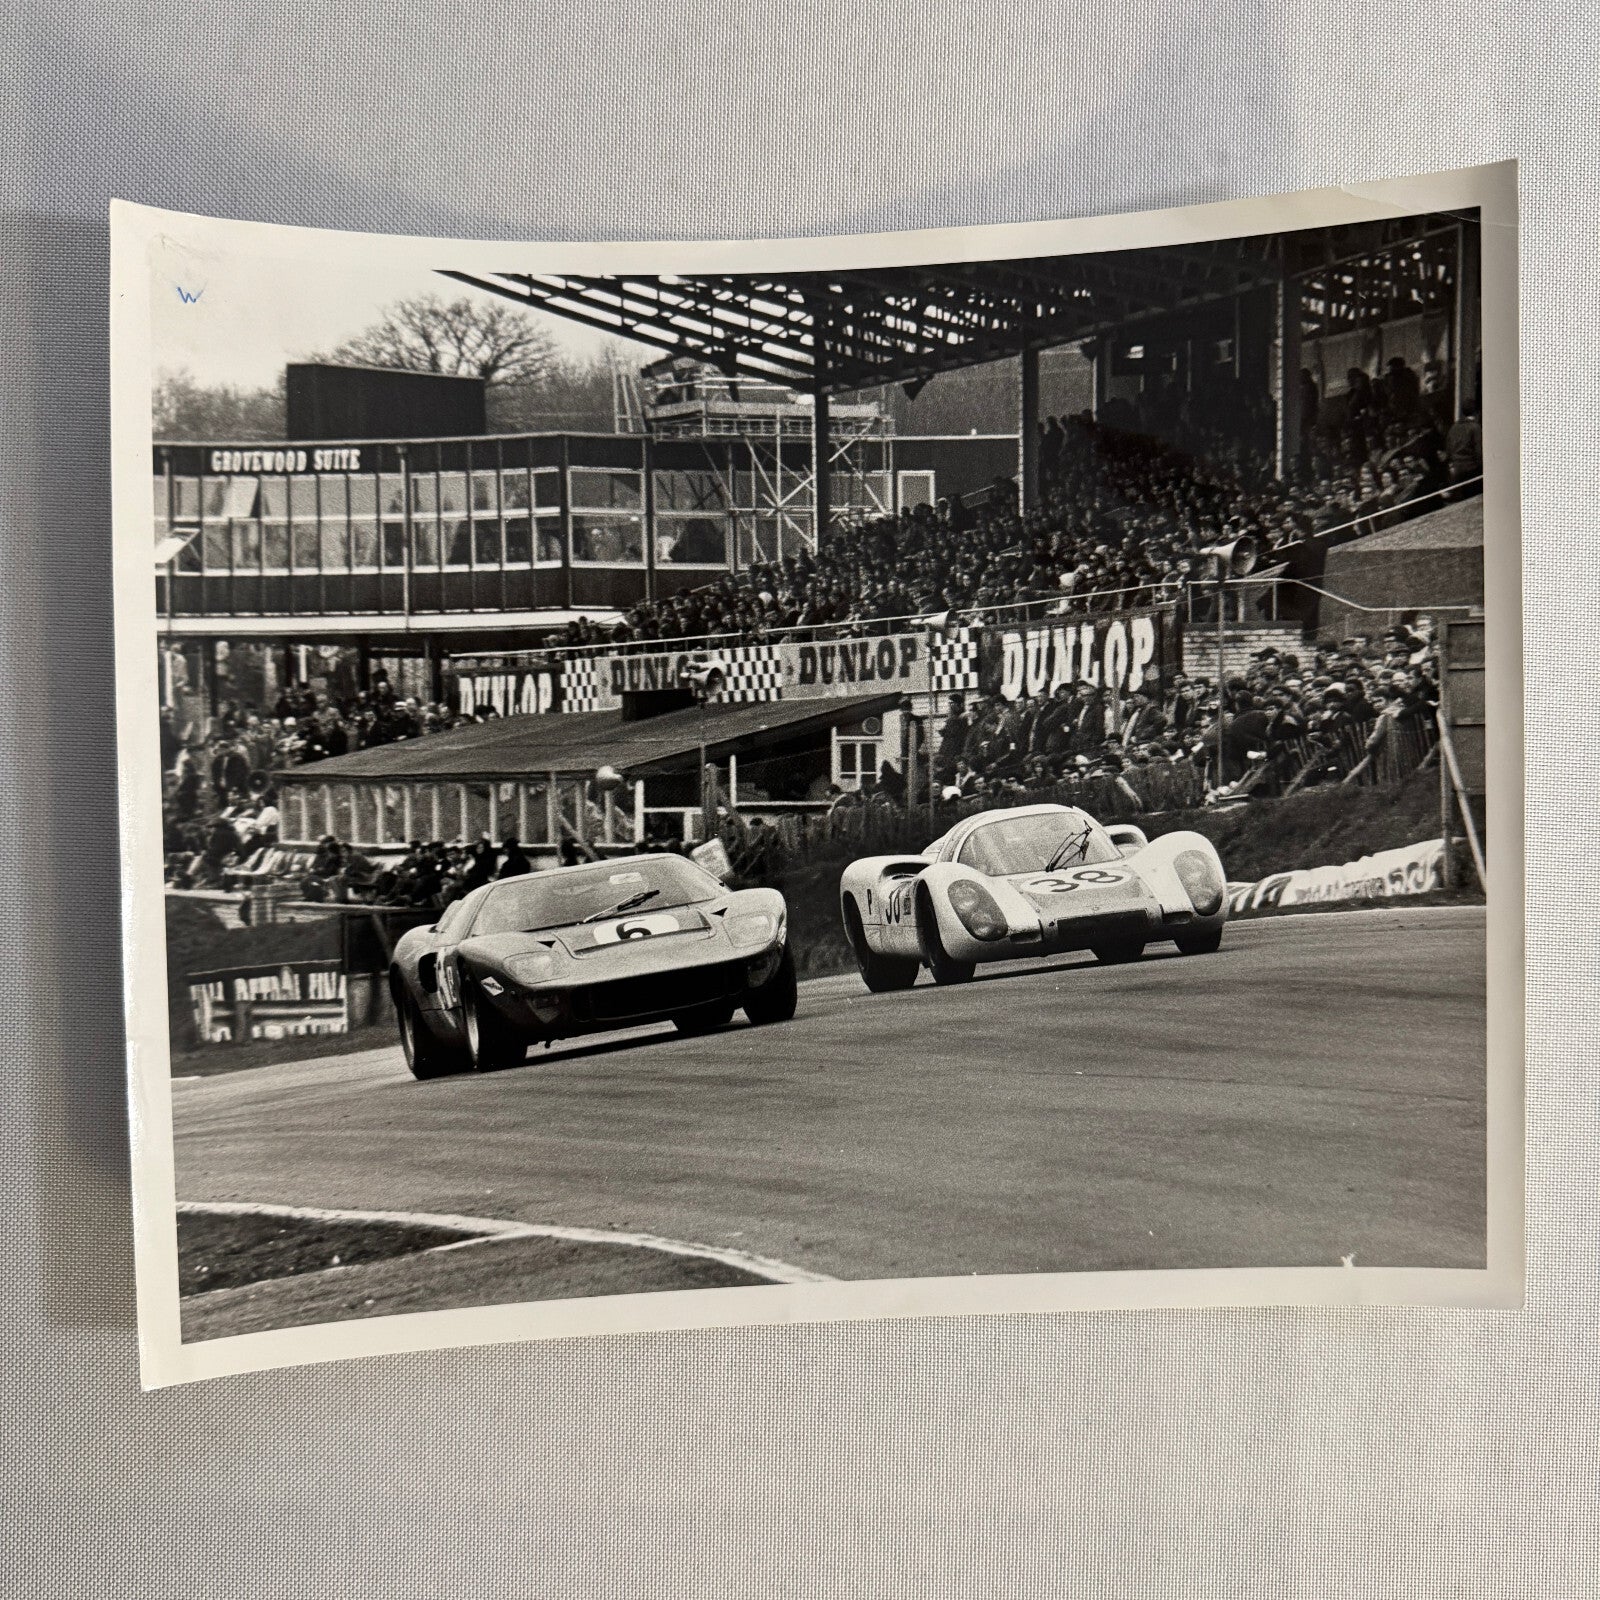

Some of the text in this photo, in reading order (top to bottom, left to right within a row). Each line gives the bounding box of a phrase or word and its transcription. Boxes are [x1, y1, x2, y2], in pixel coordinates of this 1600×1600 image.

[211, 449, 361, 472] GROVEWOOD SUITE
[799, 637, 918, 685] DUNLOP
[1000, 617, 1155, 701] DUNLOP
[458, 672, 552, 718] DUNLOP
[1029, 870, 1123, 893] 38
[615, 919, 652, 940] 6
